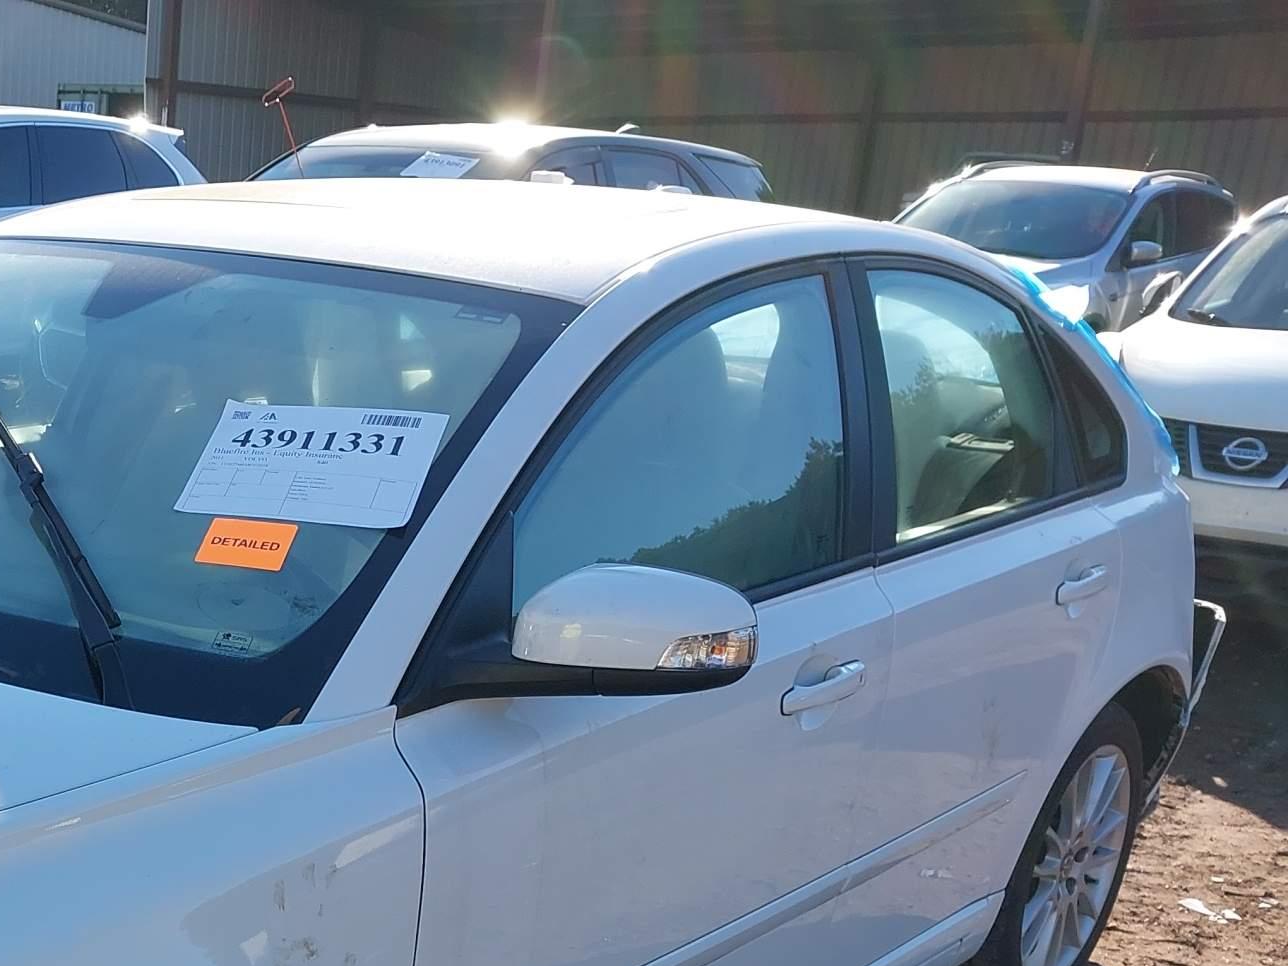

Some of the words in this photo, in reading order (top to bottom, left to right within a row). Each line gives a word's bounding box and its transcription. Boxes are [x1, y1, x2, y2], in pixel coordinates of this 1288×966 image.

[231, 428, 406, 456] 43911331
[1225, 448, 1263, 458] NISSAN
[210, 536, 281, 552] DETAILED
